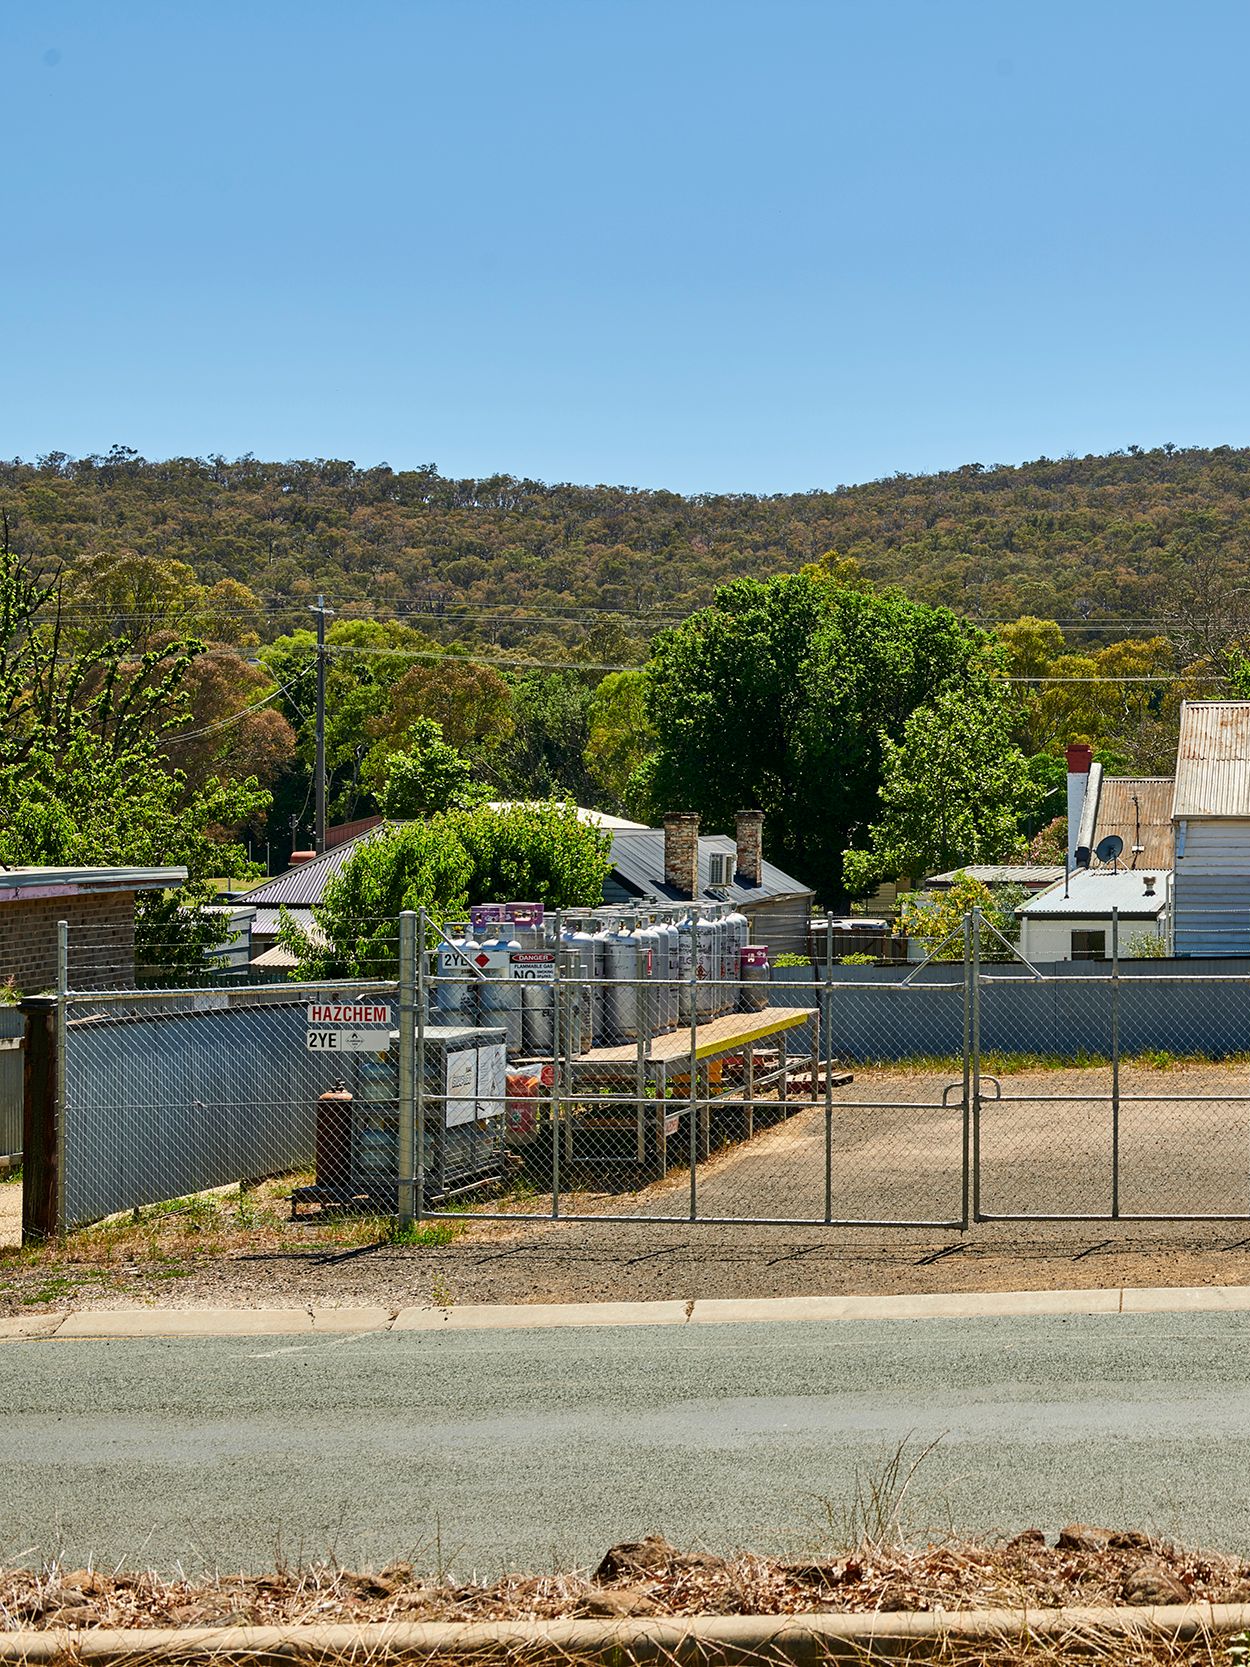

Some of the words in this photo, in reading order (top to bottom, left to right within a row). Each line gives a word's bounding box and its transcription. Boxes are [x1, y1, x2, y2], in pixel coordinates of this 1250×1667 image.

[514, 969, 536, 979] NO
[312, 1006, 387, 1022] HAZCHEM
[309, 1032, 337, 1048] 2YE
